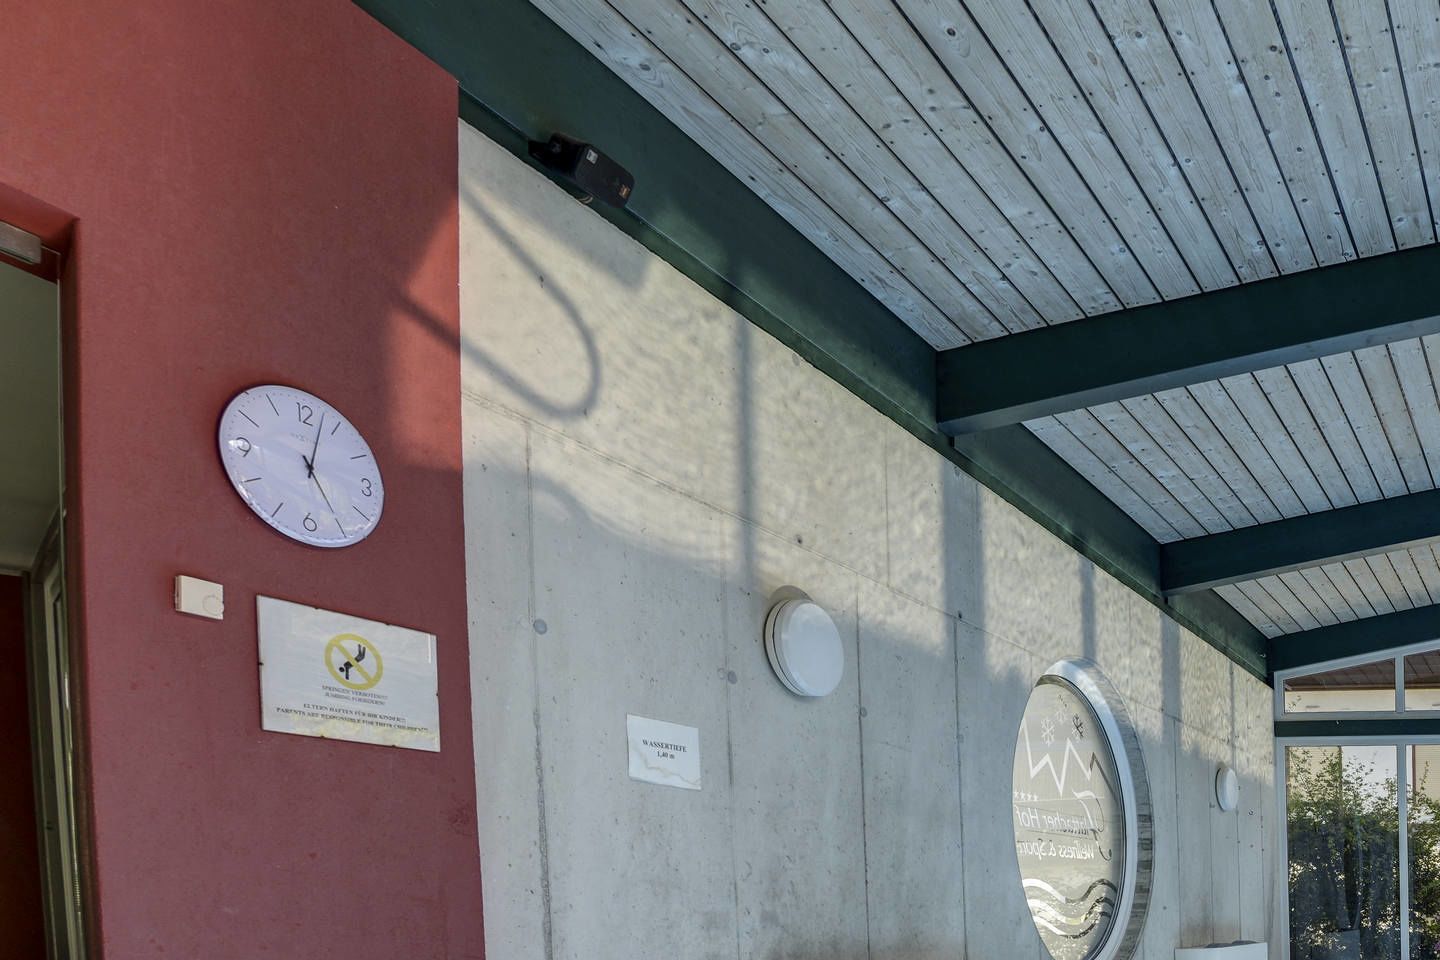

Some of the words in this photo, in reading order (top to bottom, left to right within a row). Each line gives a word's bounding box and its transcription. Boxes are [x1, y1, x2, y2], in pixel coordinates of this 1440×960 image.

[296, 401, 313, 427] 12
[235, 436, 251, 458] 9
[360, 477, 372, 497] 3
[302, 512, 317, 532] 6
[276, 707, 306, 716] PARENTS
[303, 703, 328, 711] ELTERN
[642, 739, 688, 753] WASSERTIEFE
[657, 751, 669, 759] 1,40
